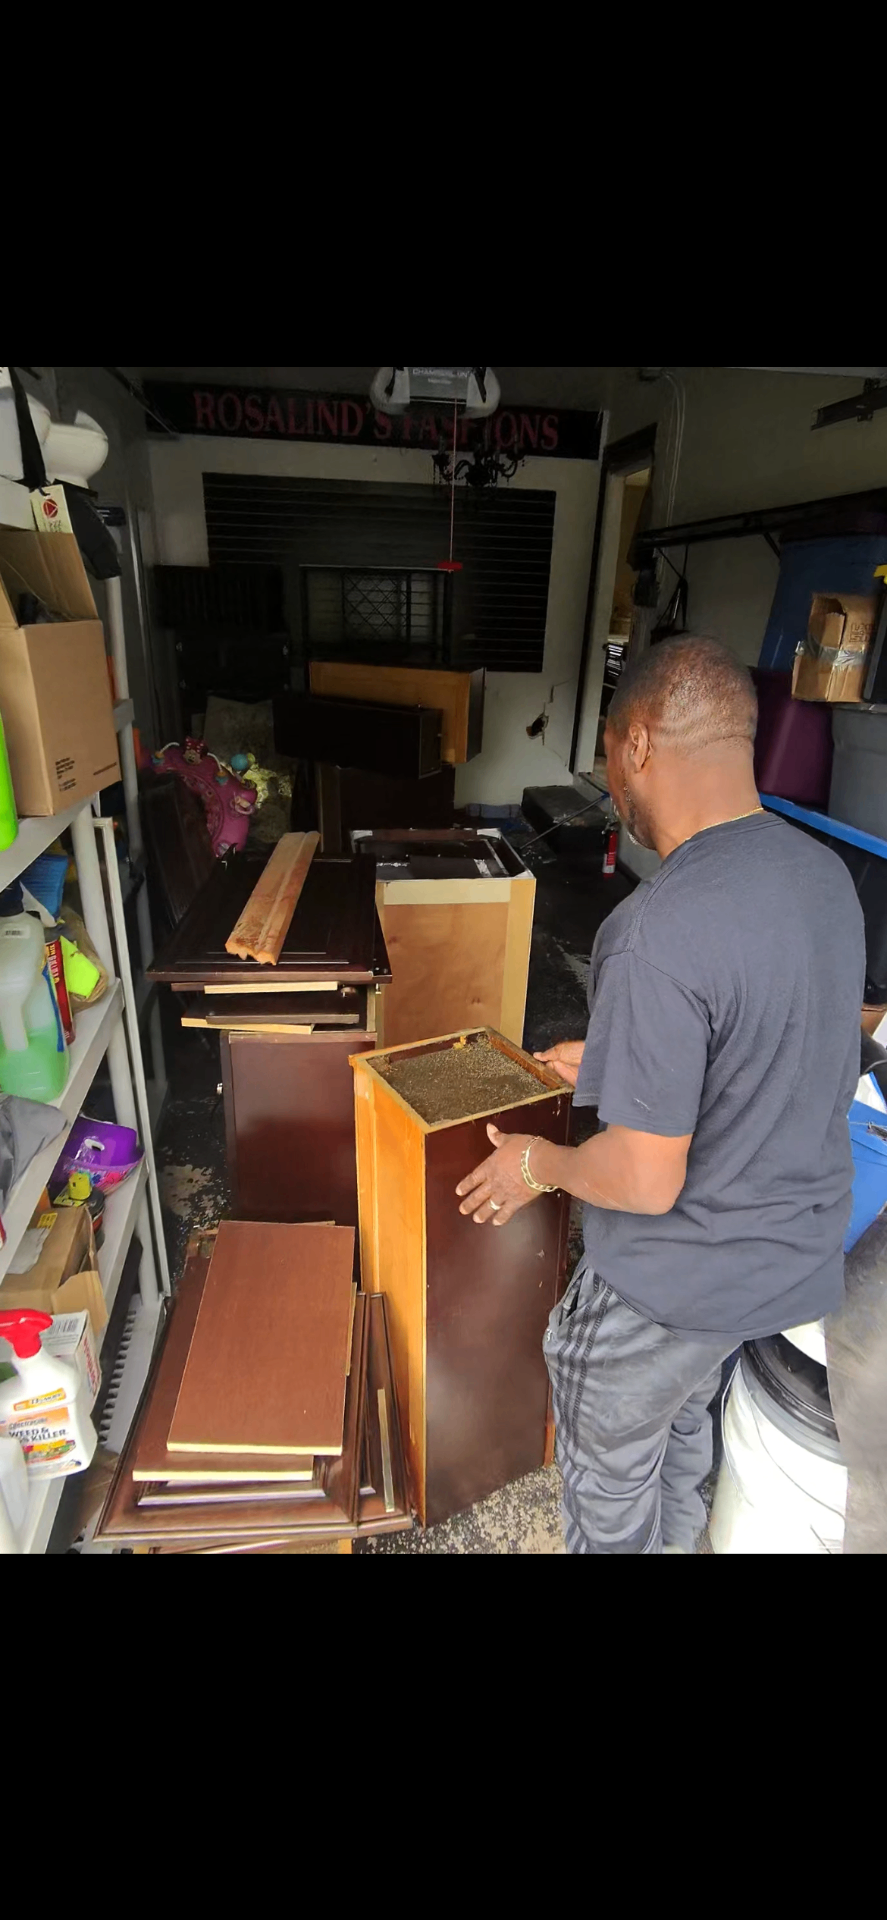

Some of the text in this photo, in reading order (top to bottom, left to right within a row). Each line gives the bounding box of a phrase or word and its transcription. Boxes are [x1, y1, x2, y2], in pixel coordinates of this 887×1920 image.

[193, 389, 393, 439] ROSALIND'S
[9, 1428, 39, 1438] WEED
[31, 1429, 66, 1442] KILLER
